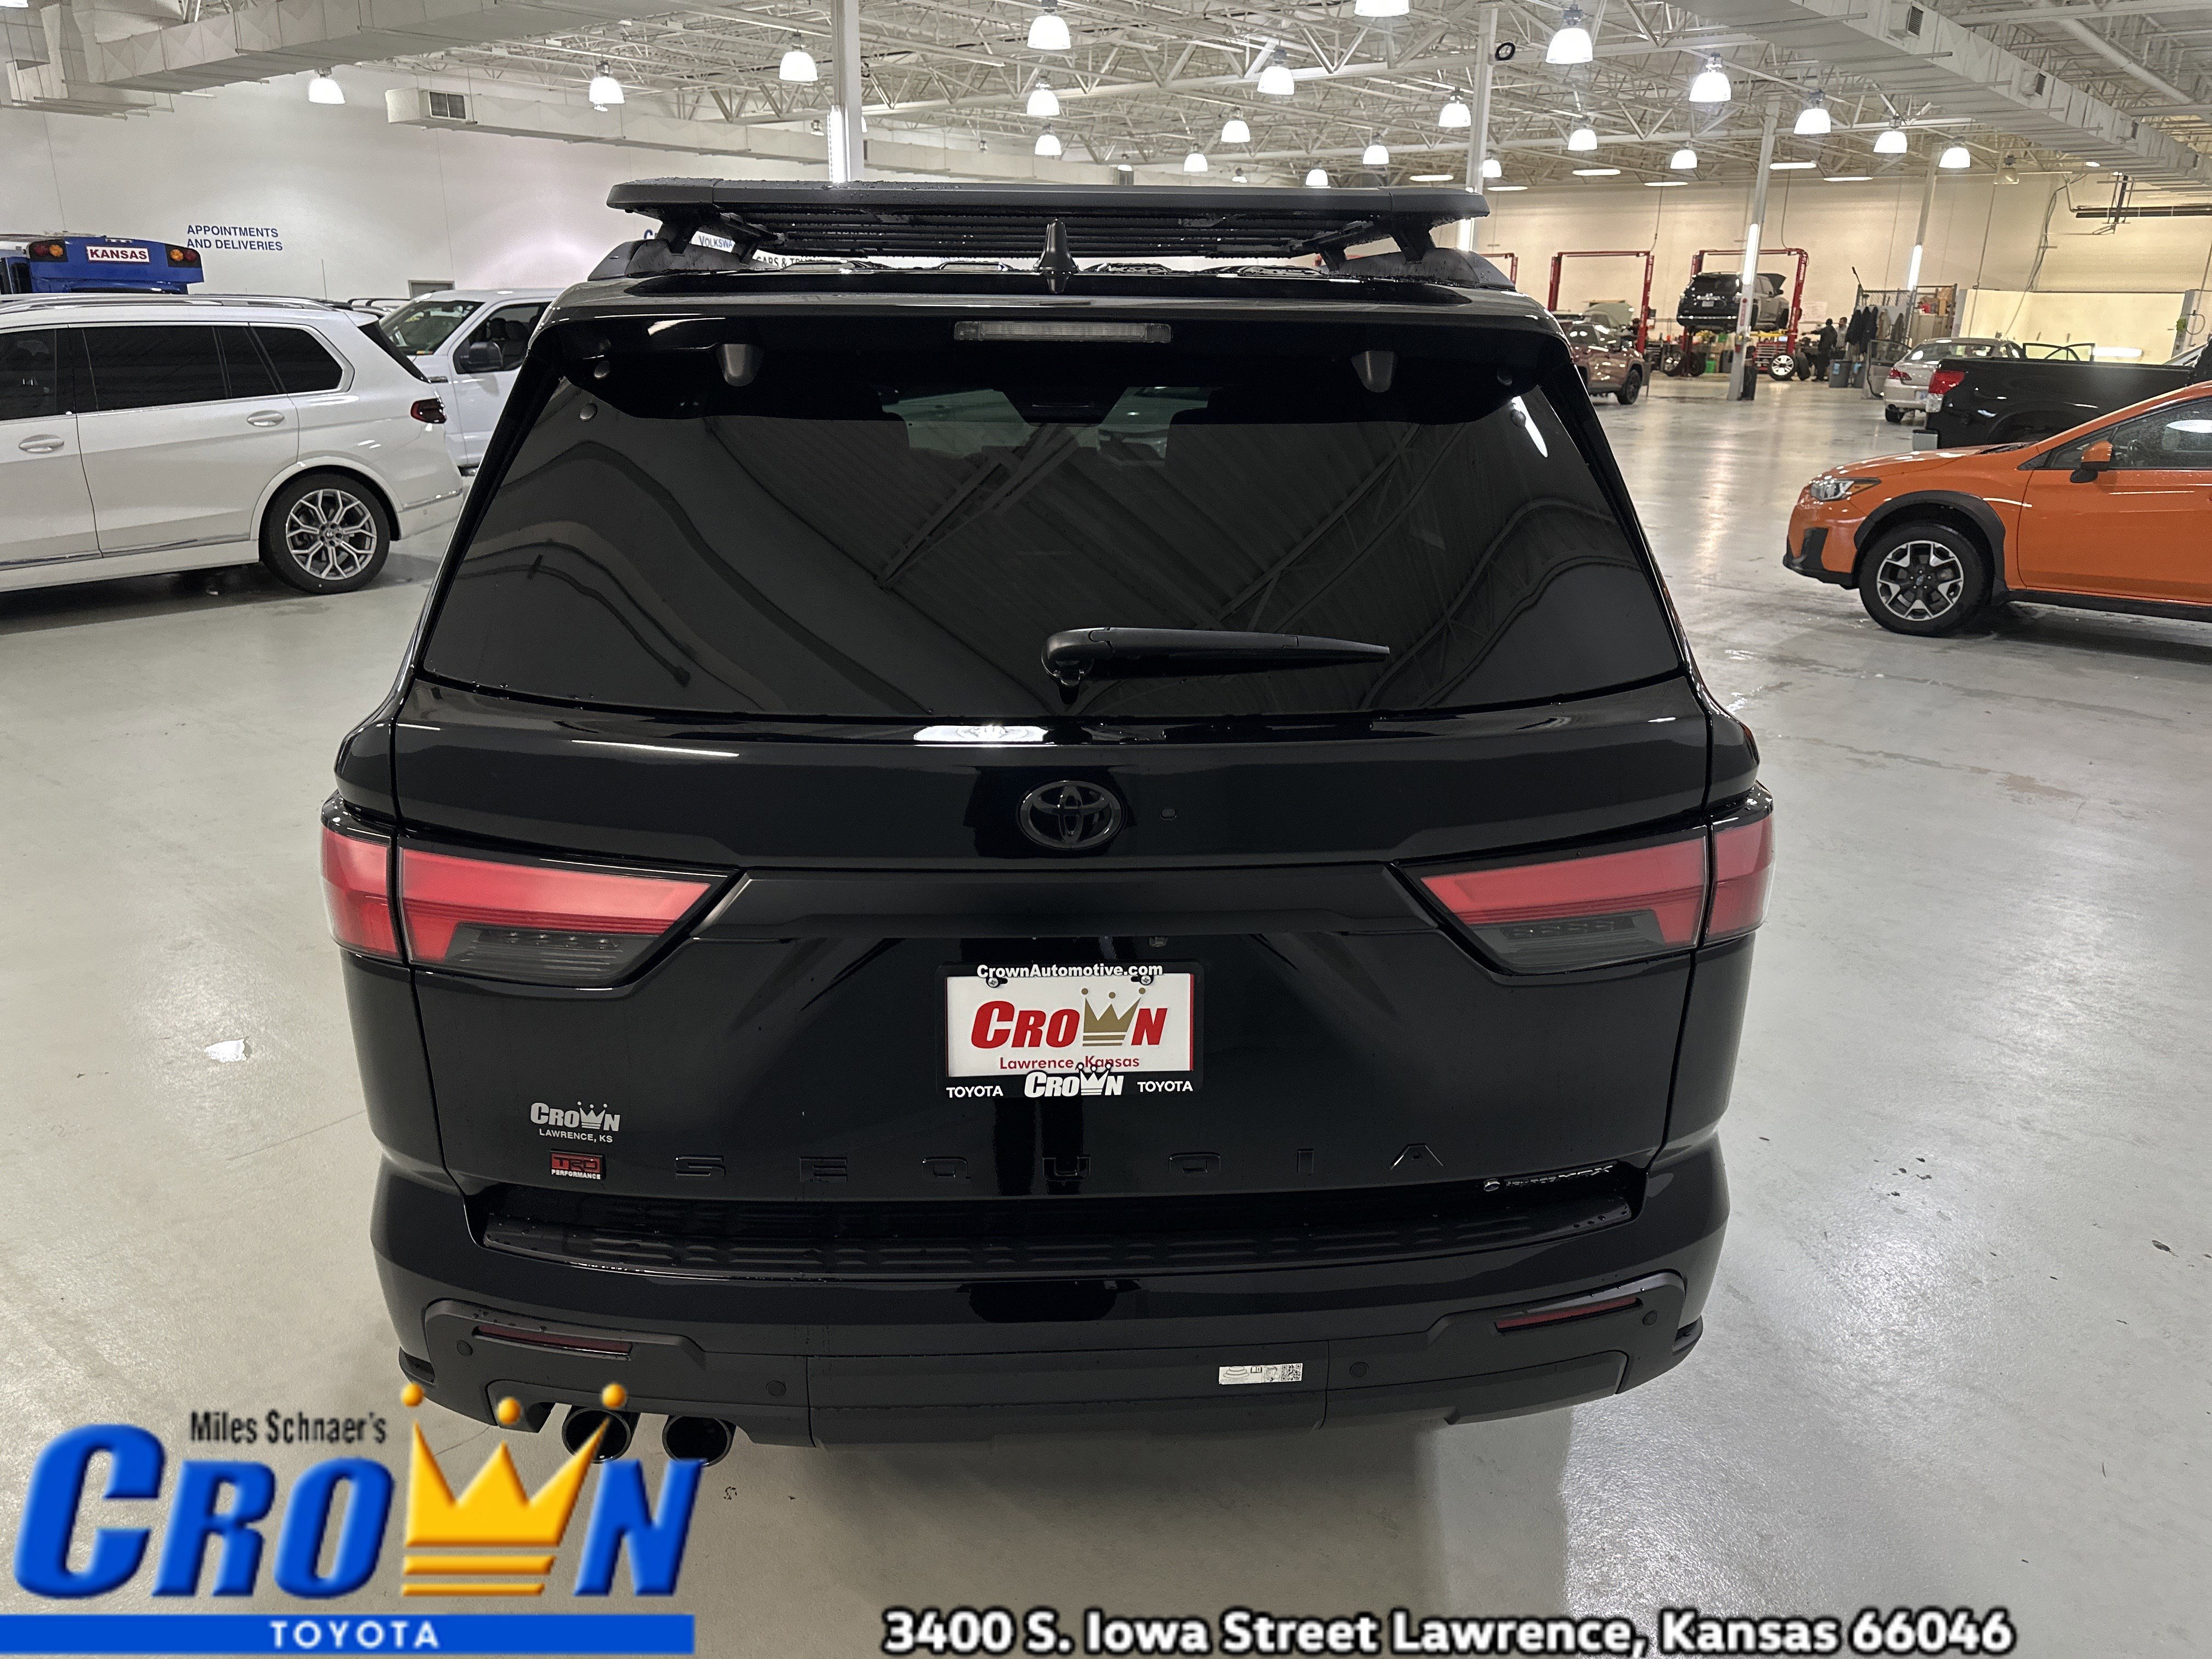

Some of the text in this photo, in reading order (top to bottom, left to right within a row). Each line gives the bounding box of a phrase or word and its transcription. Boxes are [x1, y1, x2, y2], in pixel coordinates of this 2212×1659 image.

[187, 225, 279, 238] APPOINTMENTS
[187, 239, 283, 251] AND DELIVERIES
[699, 235, 733, 248] VOLKSWA
[89, 249, 148, 260] KANSAS
[977, 963, 1163, 979] CrownAutomotive.com
[1000, 1056, 1139, 1070] Lawrence, Kansas
[946, 1085, 1003, 1098] TOYOTA
[1137, 1080, 1193, 1093] TOYOTA
[539, 1128, 613, 1143] LAWRENCE, KS
[551, 1169, 601, 1180] PERFORMANCE
